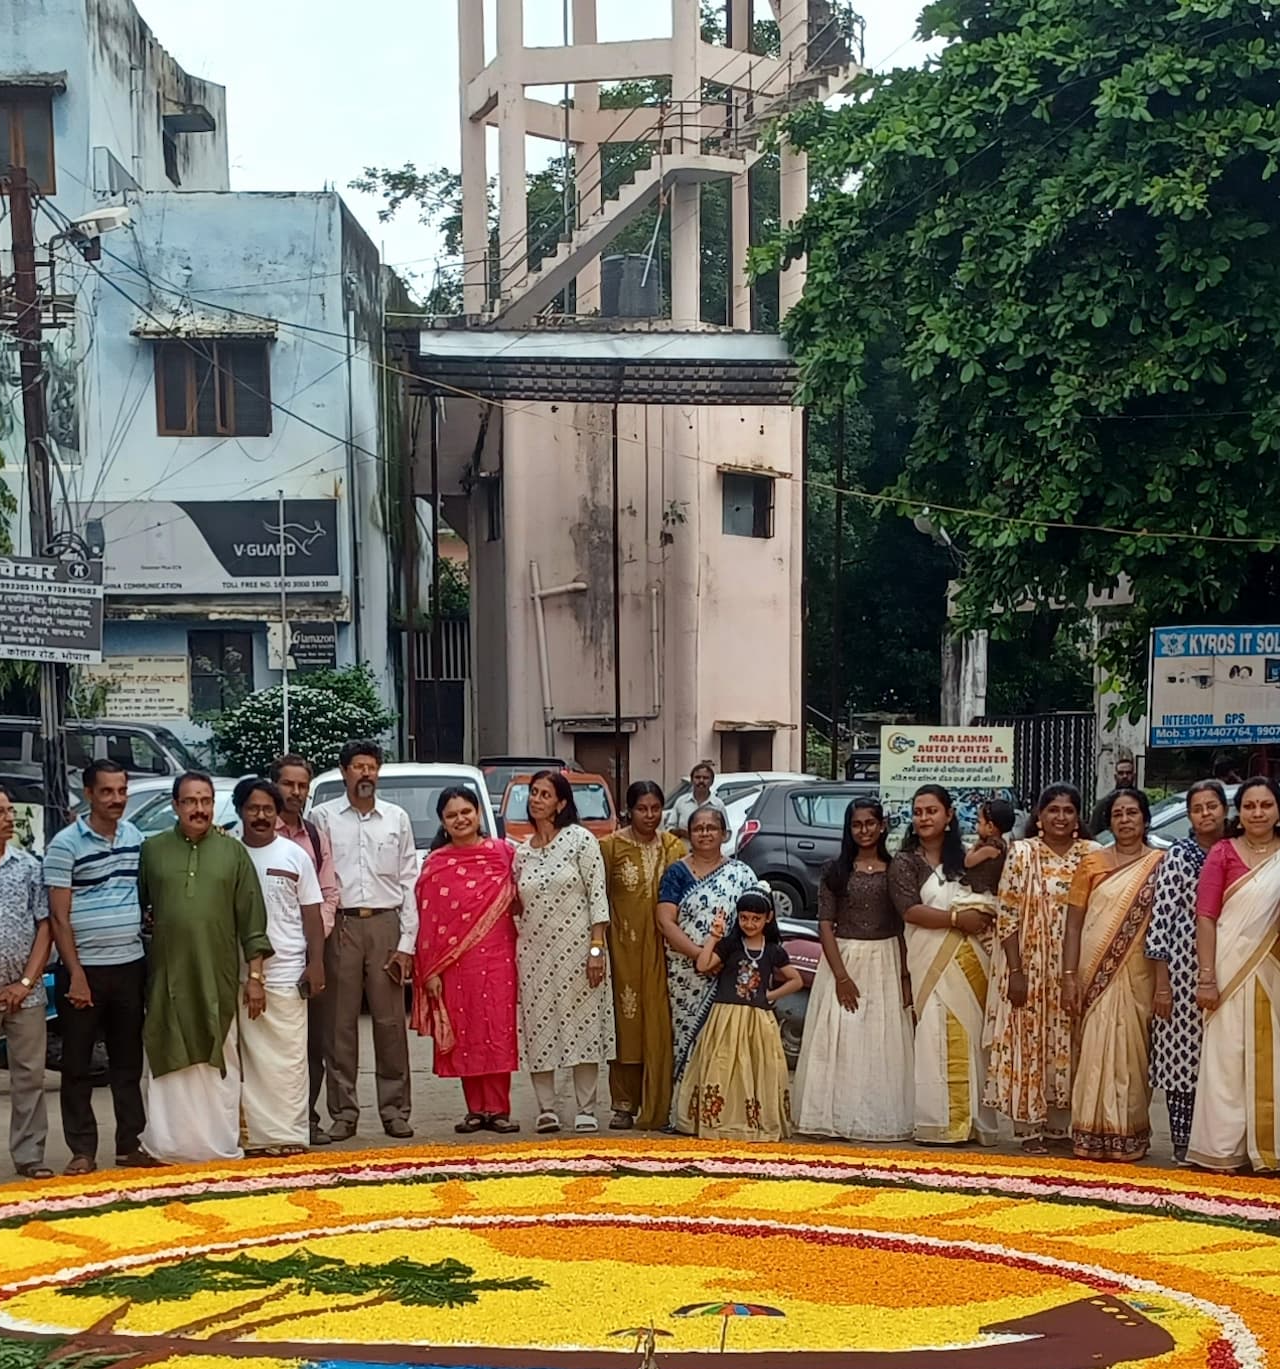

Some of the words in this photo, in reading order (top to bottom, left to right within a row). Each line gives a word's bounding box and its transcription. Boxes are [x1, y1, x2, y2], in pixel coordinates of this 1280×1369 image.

[123, 582, 183, 590] COMMUNICATION
[222, 581, 239, 589] TOLL
[241, 581, 258, 589] FREE
[1189, 632, 1236, 655] KYROS
[1239, 632, 1253, 653] IT
[1162, 714, 1214, 726] INTERCOM
[1224, 712, 1246, 725] GPS
[928, 734, 955, 744] MAA
[957, 734, 993, 744] LAXMI
[917, 744, 949, 753] AUTO
[951, 744, 991, 753] PARTS
[994, 745, 1004, 753] &
[912, 754, 962, 764] SERVICE
[963, 754, 1009, 764] CENTER
